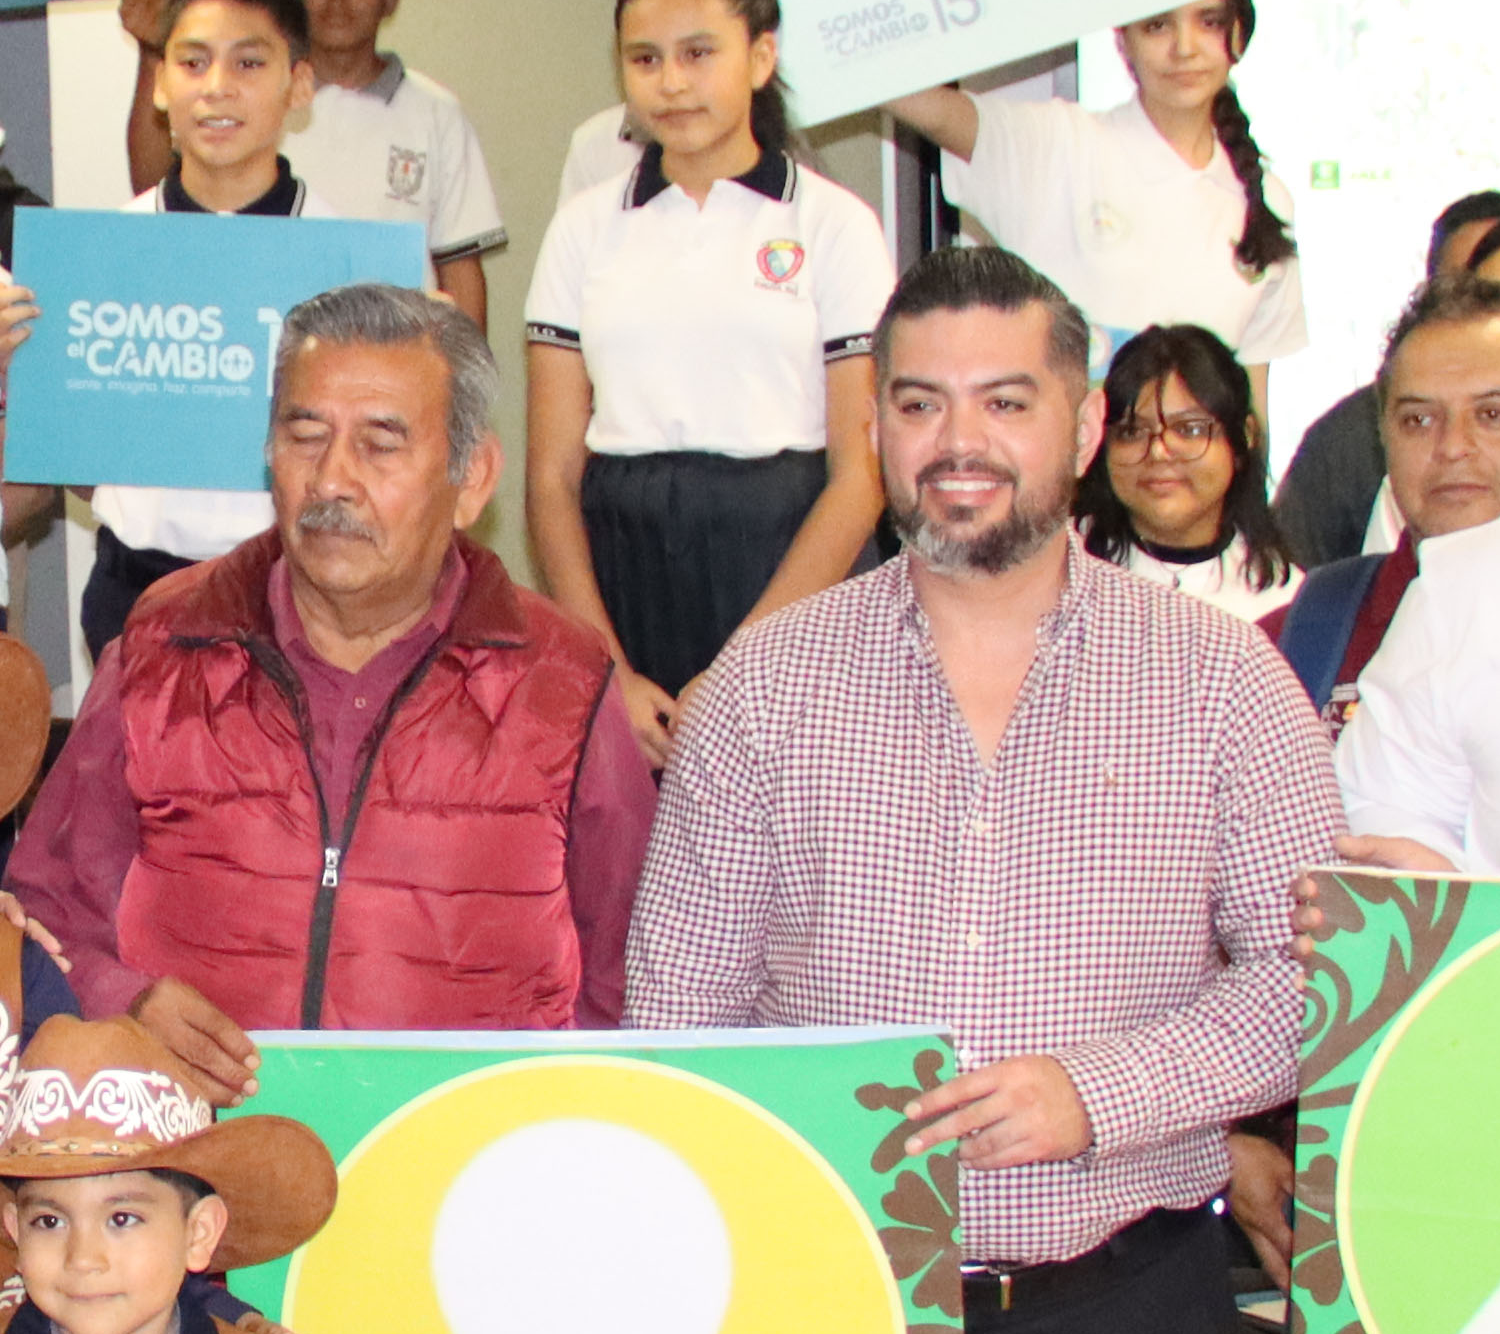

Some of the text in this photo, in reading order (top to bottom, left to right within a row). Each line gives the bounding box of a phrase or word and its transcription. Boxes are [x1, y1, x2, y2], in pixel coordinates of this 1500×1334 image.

[836, 12, 930, 57] CAMBIO
[66, 339, 255, 382] el CAMBIO
[68, 300, 284, 397] SOMOS 1
